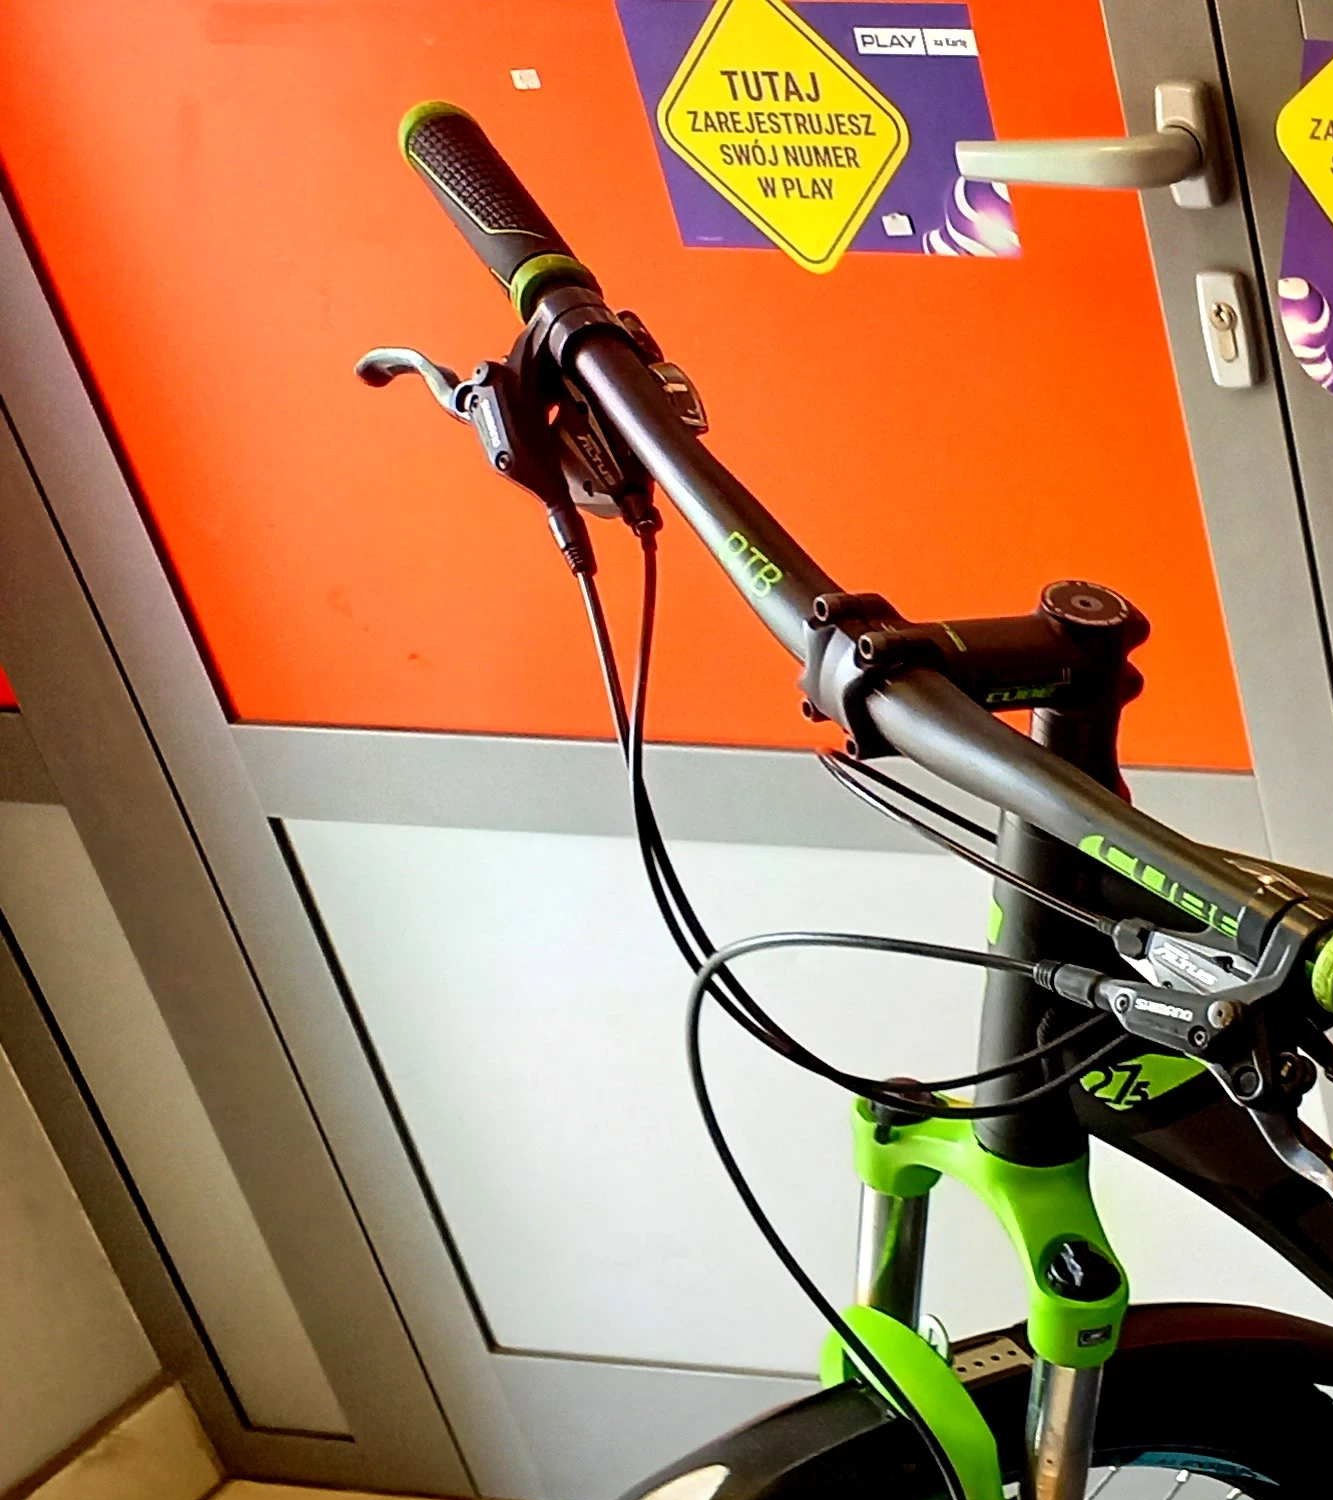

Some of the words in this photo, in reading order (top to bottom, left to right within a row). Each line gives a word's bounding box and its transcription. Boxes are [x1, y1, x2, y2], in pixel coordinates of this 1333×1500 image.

[860, 34, 916, 48] PLAY
[720, 69, 821, 103] TUTAJ
[687, 111, 877, 137] ZAREJESTRUJESZ
[719, 139, 779, 167] SWÓJ
[784, 145, 860, 169] NUMER
[757, 177, 777, 199] W
[784, 178, 834, 200] PLAY
[1134, 998, 1194, 1023] SHIMANO
